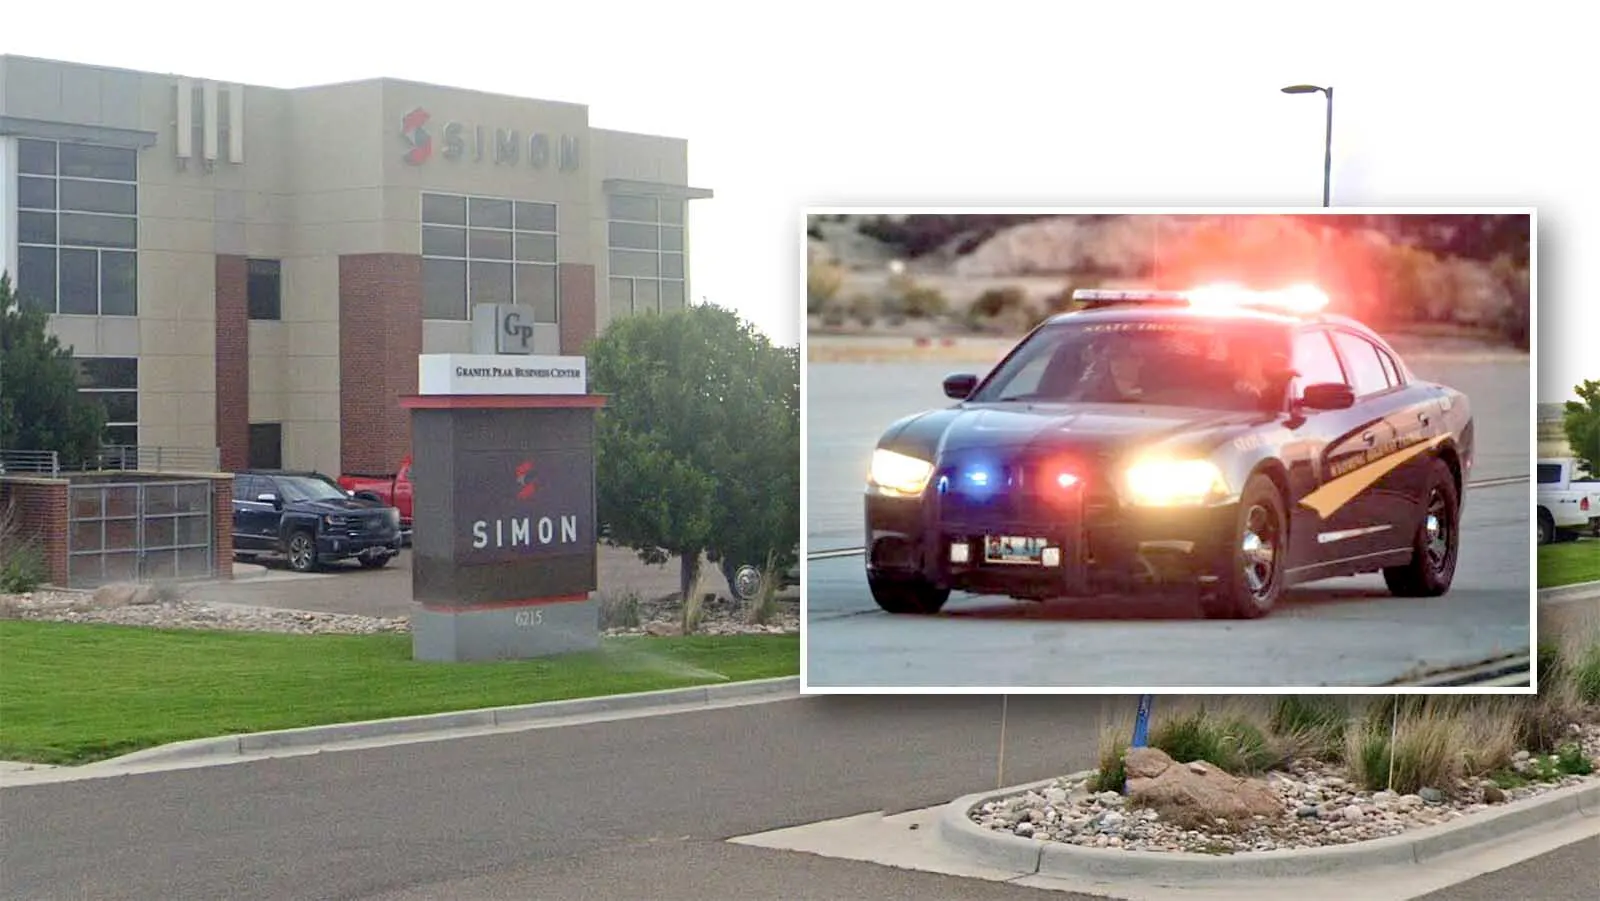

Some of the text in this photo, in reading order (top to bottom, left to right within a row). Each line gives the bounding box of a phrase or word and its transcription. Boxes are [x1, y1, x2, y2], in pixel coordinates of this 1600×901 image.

[441, 121, 580, 172] SIMON
[456, 366, 581, 378] GRANITE PEAK BUSINESS CENTER
[472, 515, 577, 549] SIMON
[515, 610, 543, 627] 6215
